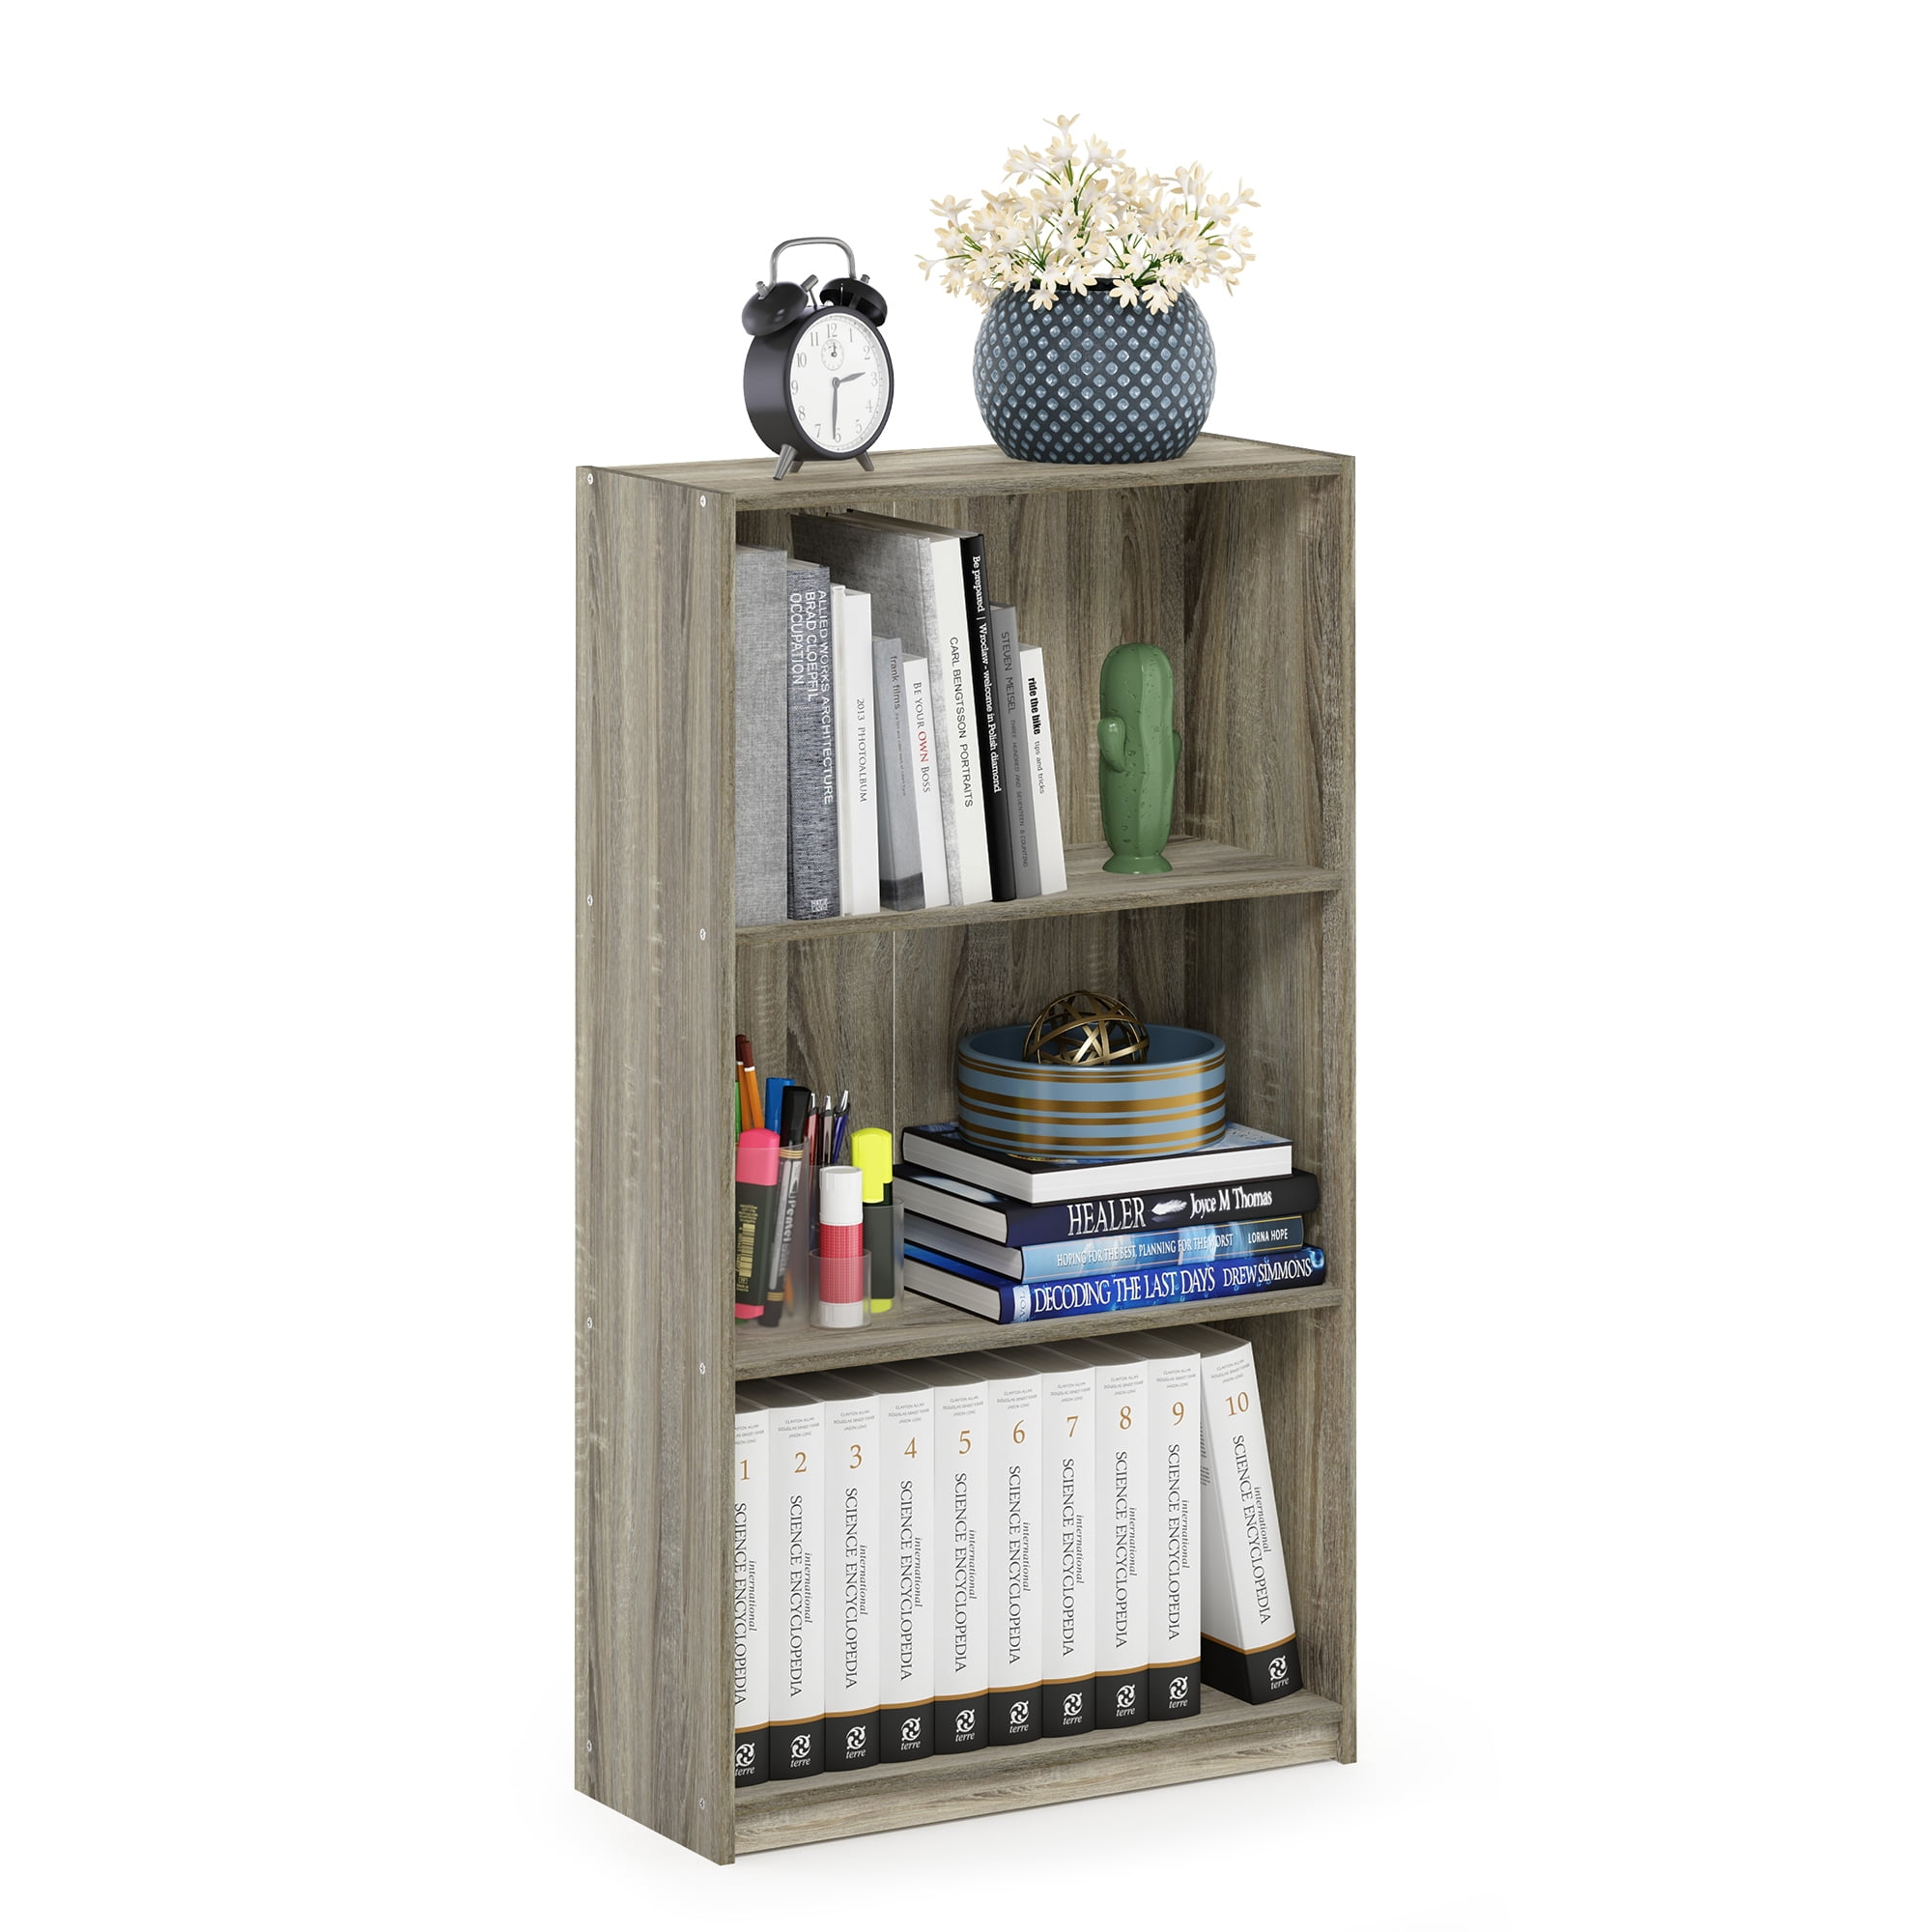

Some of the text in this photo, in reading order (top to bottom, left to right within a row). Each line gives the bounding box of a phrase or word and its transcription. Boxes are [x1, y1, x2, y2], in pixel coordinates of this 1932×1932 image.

[810, 331, 819, 347] 11
[826, 323, 838, 338] 12
[849, 327, 853, 343] 1
[797, 352, 808, 368] 10
[864, 345, 870, 360] 2
[791, 380, 799, 395] 9
[870, 372, 878, 387] 3
[798, 406, 806, 421] 8
[855, 418, 863, 434] 5
[814, 423, 822, 439] 7
[972, 555, 982, 568] Be
[971, 569, 985, 611] prepared
[789, 592, 804, 685] OCCUPATION
[805, 591, 819, 702] BRAD CLOEPFIL
[978, 623, 991, 664] Wroclaw
[1001, 632, 1012, 671] STEVEN
[890, 655, 899, 682] frank
[818, 590, 833, 805] ALLIED WORKS ARCHITECTURE
[892, 684, 903, 710] films
[982, 670, 996, 712] welcome
[1006, 677, 1016, 714] MEISEL
[1027, 677, 1040, 696] ride
[986, 713, 997, 722] in
[1029, 697, 1041, 714] the
[949, 637, 974, 808] CARL BENGTSSON PORTRAITS
[1009, 720, 1018, 739] THREE
[1031, 715, 1043, 735] bike
[917, 730, 929, 763] OWN
[987, 723, 1000, 751] Polish
[1034, 741, 1042, 755] tips
[857, 698, 867, 803] 2013 PHOTOALBUM
[1011, 742, 1020, 772] HUNDRED
[991, 752, 1003, 793] diamond
[1013, 775, 1022, 788] AND
[1037, 773, 1045, 794] tricks
[1015, 790, 1024, 826] SEVENTEEN
[1020, 835, 1029, 867] COUNTING
[783, 1200, 797, 1242] Pentel
[1067, 1186, 1272, 1236] HEALER Joyce M Thomas
[1057, 1250, 1087, 1267] HOPING
[1088, 1249, 1103, 1264] FOR
[1104, 1248, 1119, 1262] THE
[1138, 1239, 1177, 1257] PLANNING
[1178, 1237, 1193, 1252] FOR
[1194, 1237, 1208, 1250] THE
[1208, 1233, 1234, 1248] WORST
[1248, 1231, 1269, 1244] LORNA
[1270, 1228, 1289, 1241] HOPE
[1035, 1258, 1313, 1313] DECODING THE LAST DAYS DREW SIMMONS
[1172, 1401, 1185, 1427] 9
[1225, 1391, 1249, 1417] 10
[1066, 1415, 1079, 1438] 7
[1119, 1406, 1132, 1430] 8
[957, 1430, 972, 1455] 5
[1012, 1419, 1026, 1444] 6
[849, 1444, 863, 1469] 3
[903, 1436, 917, 1459] 4
[740, 1460, 751, 1481] 1
[794, 1452, 808, 1473] 2
[1233, 1435, 1271, 1625] SCIENCE ENCYCLOPEDIA
[1254, 1487, 1271, 1553] international
[1116, 1451, 1127, 1648] SCIENCE ENCYCLOPEDIA
[1168, 1444, 1180, 1640] SCIENCE ENCYCLOPEDIA
[1009, 1465, 1021, 1664] SCIENCE ENCYCLOPEDIA
[1063, 1458, 1074, 1657] SCIENCE ENCYCLOPEDIA
[860, 1545, 868, 1615] international
[900, 1480, 913, 1681] SCIENCE ENCYCLOPEDIA
[914, 1537, 923, 1607] international
[954, 1472, 967, 1672] SCIENCE ENCYCLOPEDIA
[749, 1560, 757, 1632] international
[790, 1495, 803, 1697] SCIENCE ENCYCLOPEDIA
[845, 1488, 858, 1689] SCIENCE ENCYCLOPEDIA
[735, 1503, 747, 1705] SCIENCE ENCYCLOPEDIA
[1270, 1677, 1290, 1690] terre
[1116, 1707, 1135, 1718] terre
[1168, 1698, 1188, 1709] terre
[1009, 1723, 1030, 1734] terre
[1063, 1715, 1083, 1725] terre
[900, 1740, 921, 1750] terre
[954, 1731, 976, 1743] terre
[790, 1757, 811, 1768] terre
[845, 1748, 867, 1759] terre
[735, 1766, 755, 1776] terre
